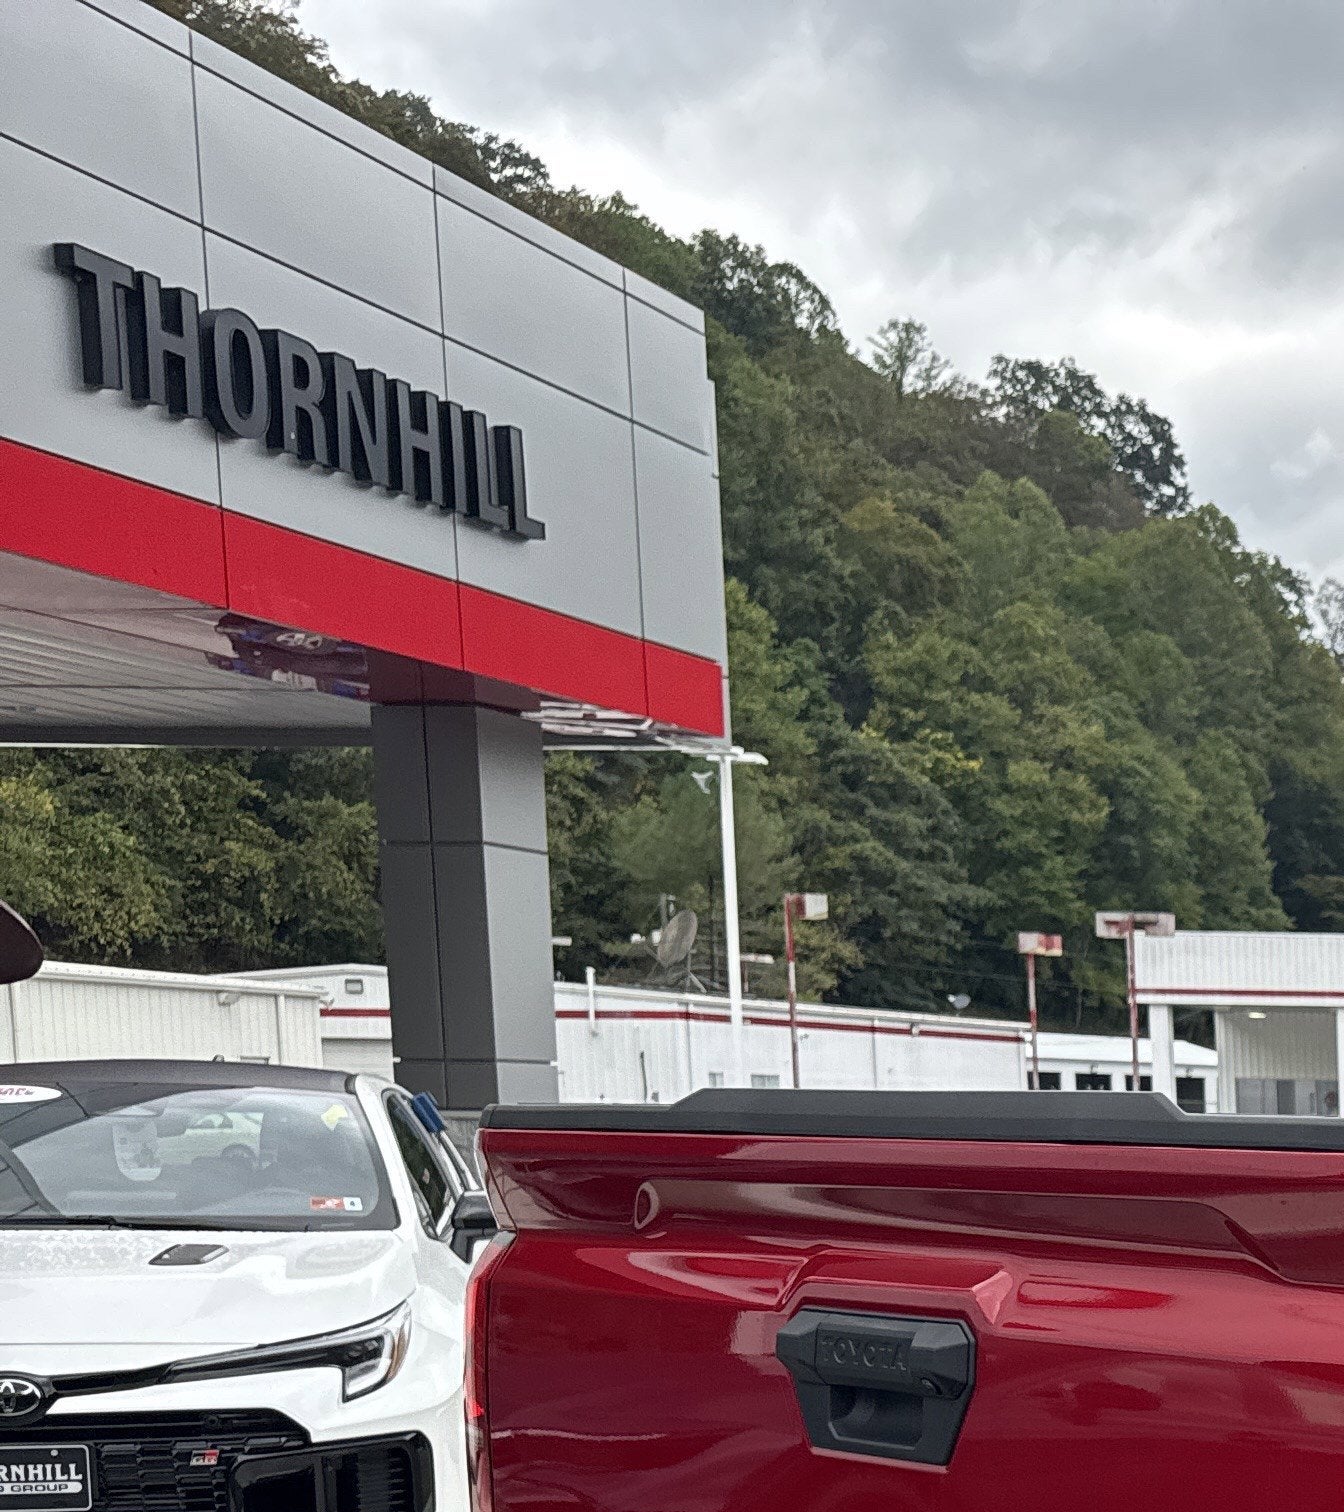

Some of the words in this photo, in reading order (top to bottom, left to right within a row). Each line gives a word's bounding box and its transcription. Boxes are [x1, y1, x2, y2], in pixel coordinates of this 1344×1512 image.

[54, 243, 546, 540] THORNHILL
[821, 1339, 907, 1371] TOYOTA
[11, 1483, 69, 1493] GROUP
